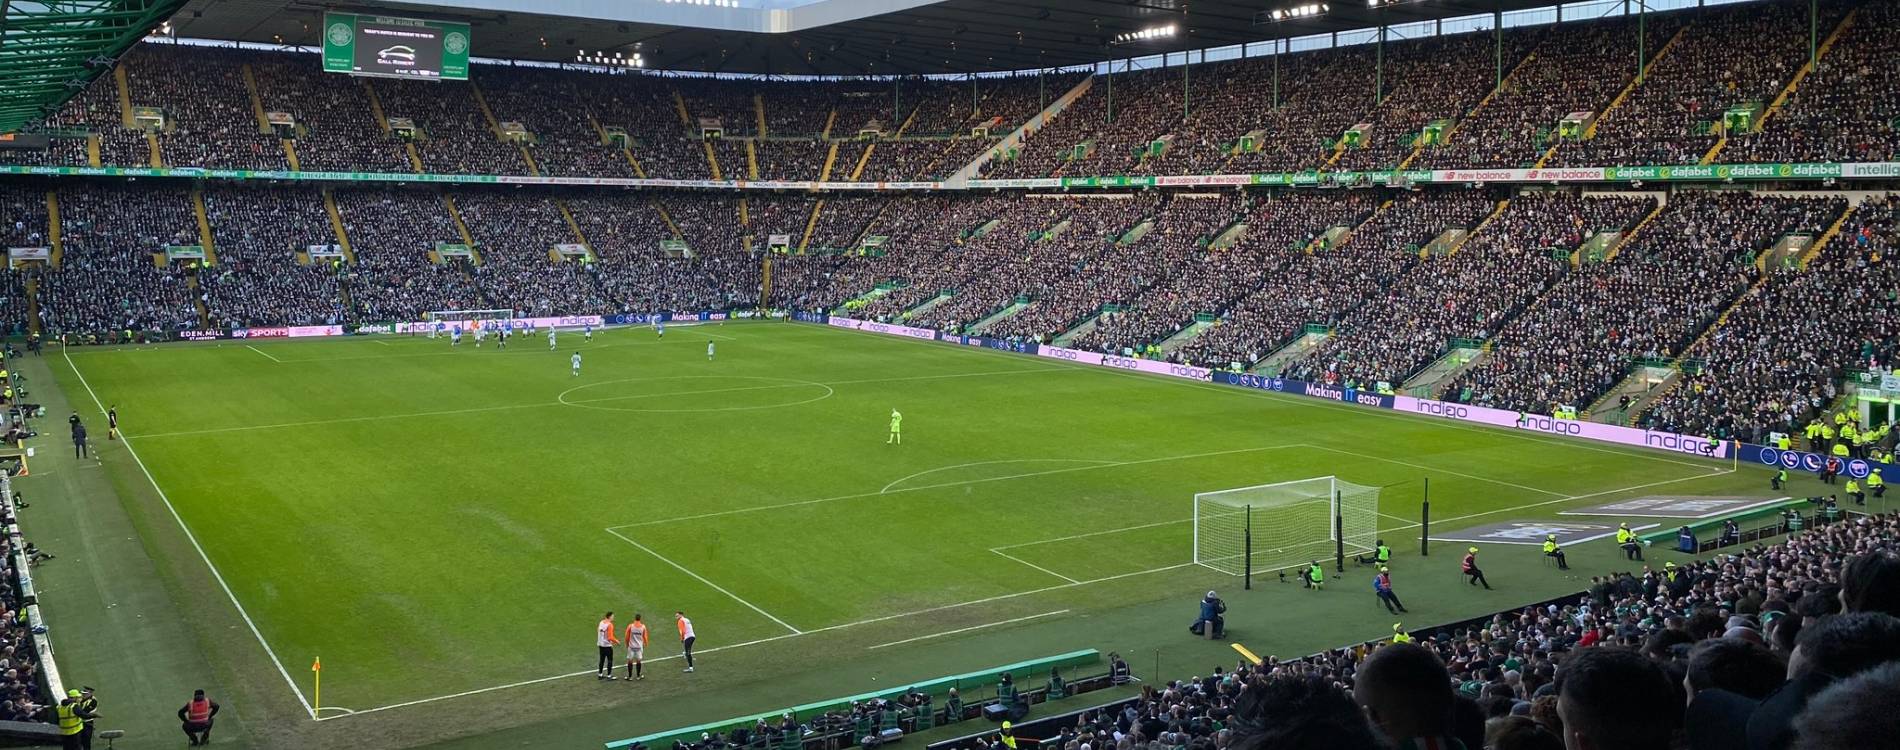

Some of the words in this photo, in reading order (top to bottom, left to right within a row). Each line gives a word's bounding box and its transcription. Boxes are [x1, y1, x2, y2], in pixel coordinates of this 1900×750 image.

[1476, 172, 1511, 180] balance
[1562, 170, 1600, 178] balance
[1617, 167, 1654, 178] dafabet
[1671, 167, 1712, 178] dafabet
[1730, 166, 1774, 177] dafabet
[1793, 165, 1840, 176] dafabet
[1259, 173, 1283, 182] dafabet
[671, 312, 699, 321] Making
[700, 312, 708, 320] IT
[232, 330, 248, 338] sky
[251, 328, 288, 337] SPORTS
[359, 324, 391, 333] dafabet
[942, 333, 960, 344] Making
[962, 335, 968, 343] IT
[969, 338, 981, 347] easy
[1170, 364, 1205, 381] indigo
[1306, 384, 1342, 400] Making
[1345, 387, 1355, 402] IT
[1358, 394, 1382, 408] easy
[1418, 399, 1467, 419] indigo
